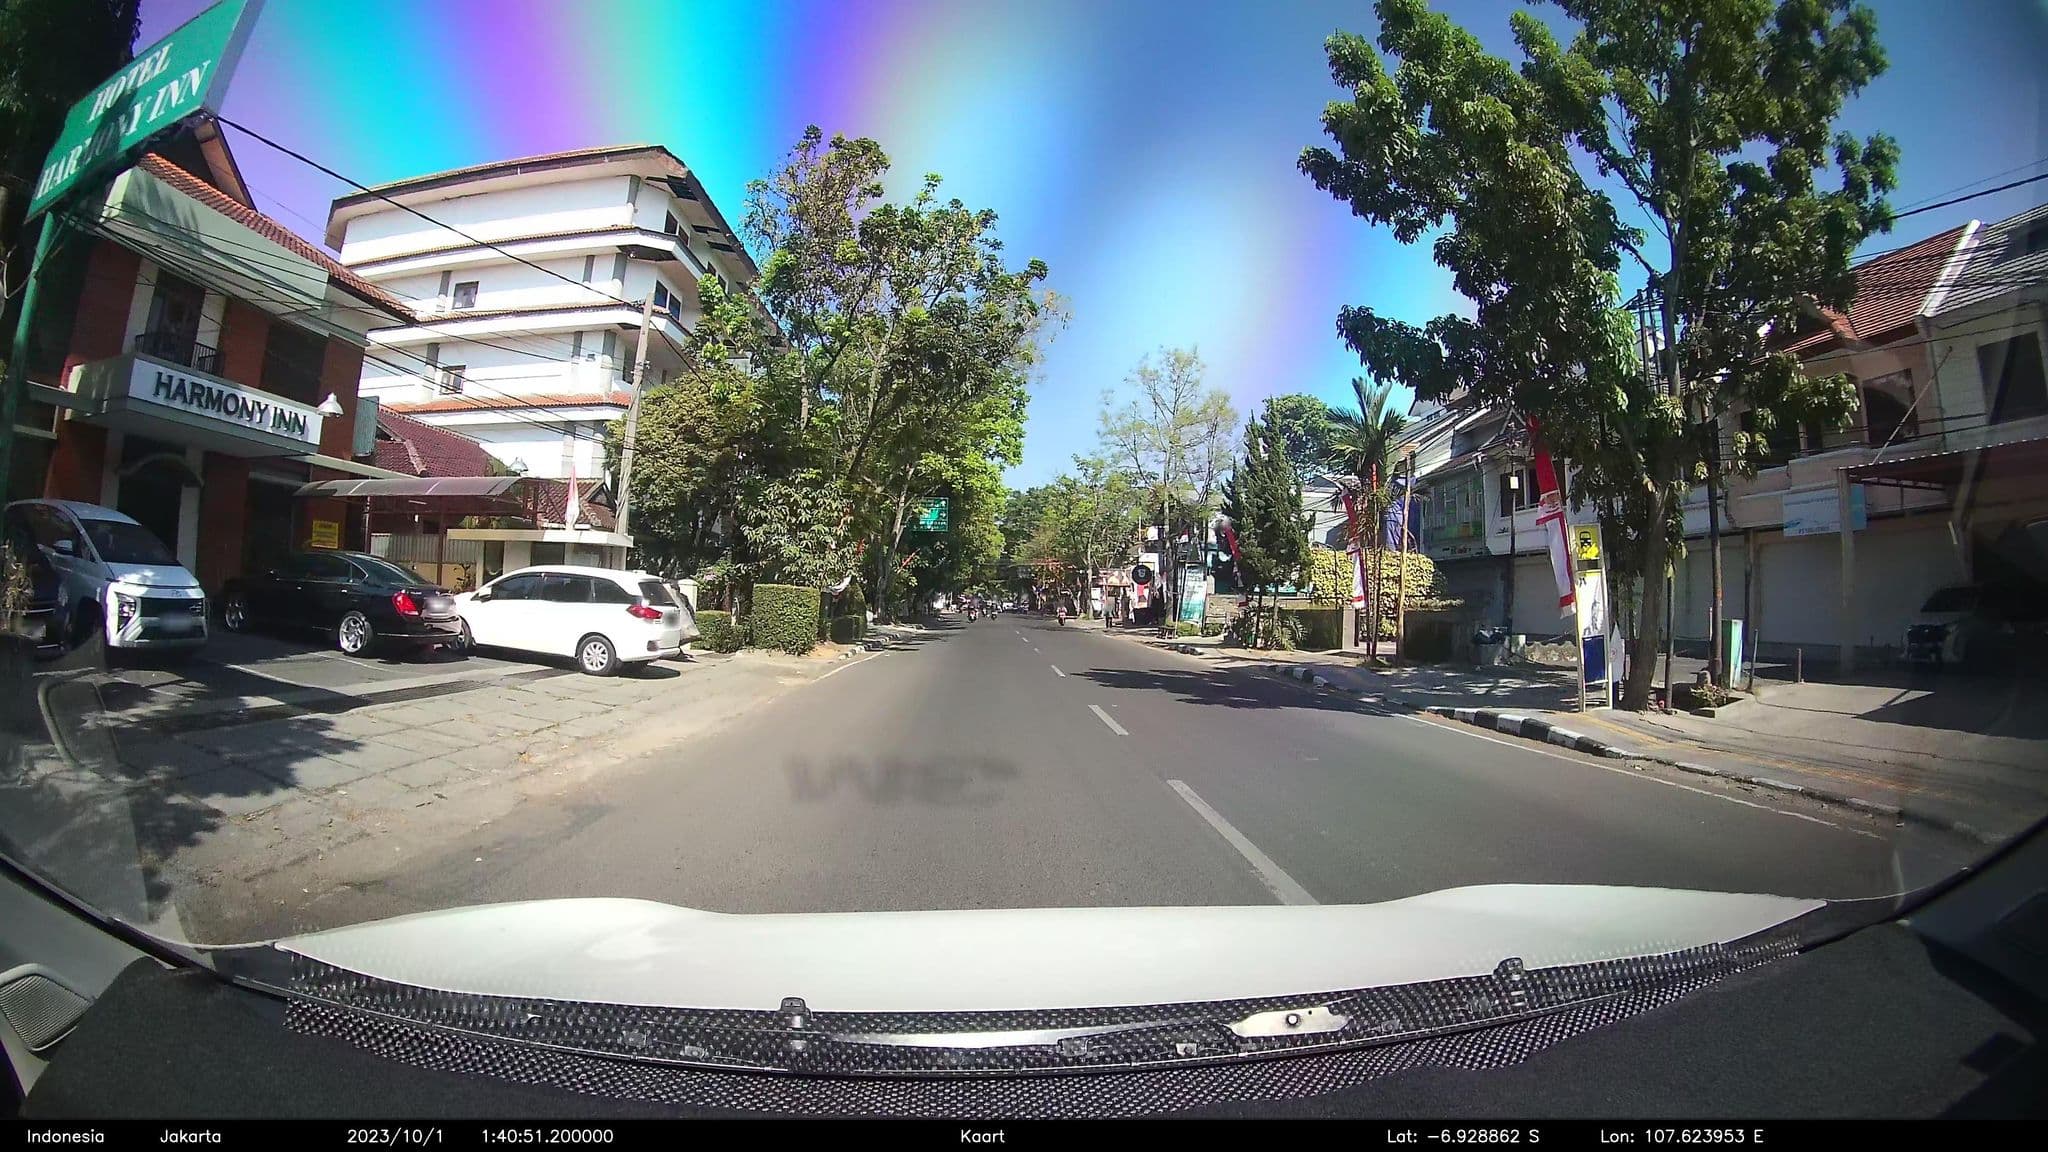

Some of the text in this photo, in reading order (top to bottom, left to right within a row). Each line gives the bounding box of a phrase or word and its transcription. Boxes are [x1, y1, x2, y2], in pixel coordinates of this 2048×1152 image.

[87, 43, 173, 123] HOTEL
[147, 60, 211, 123] INN
[152, 371, 308, 435] HARMONY INN
